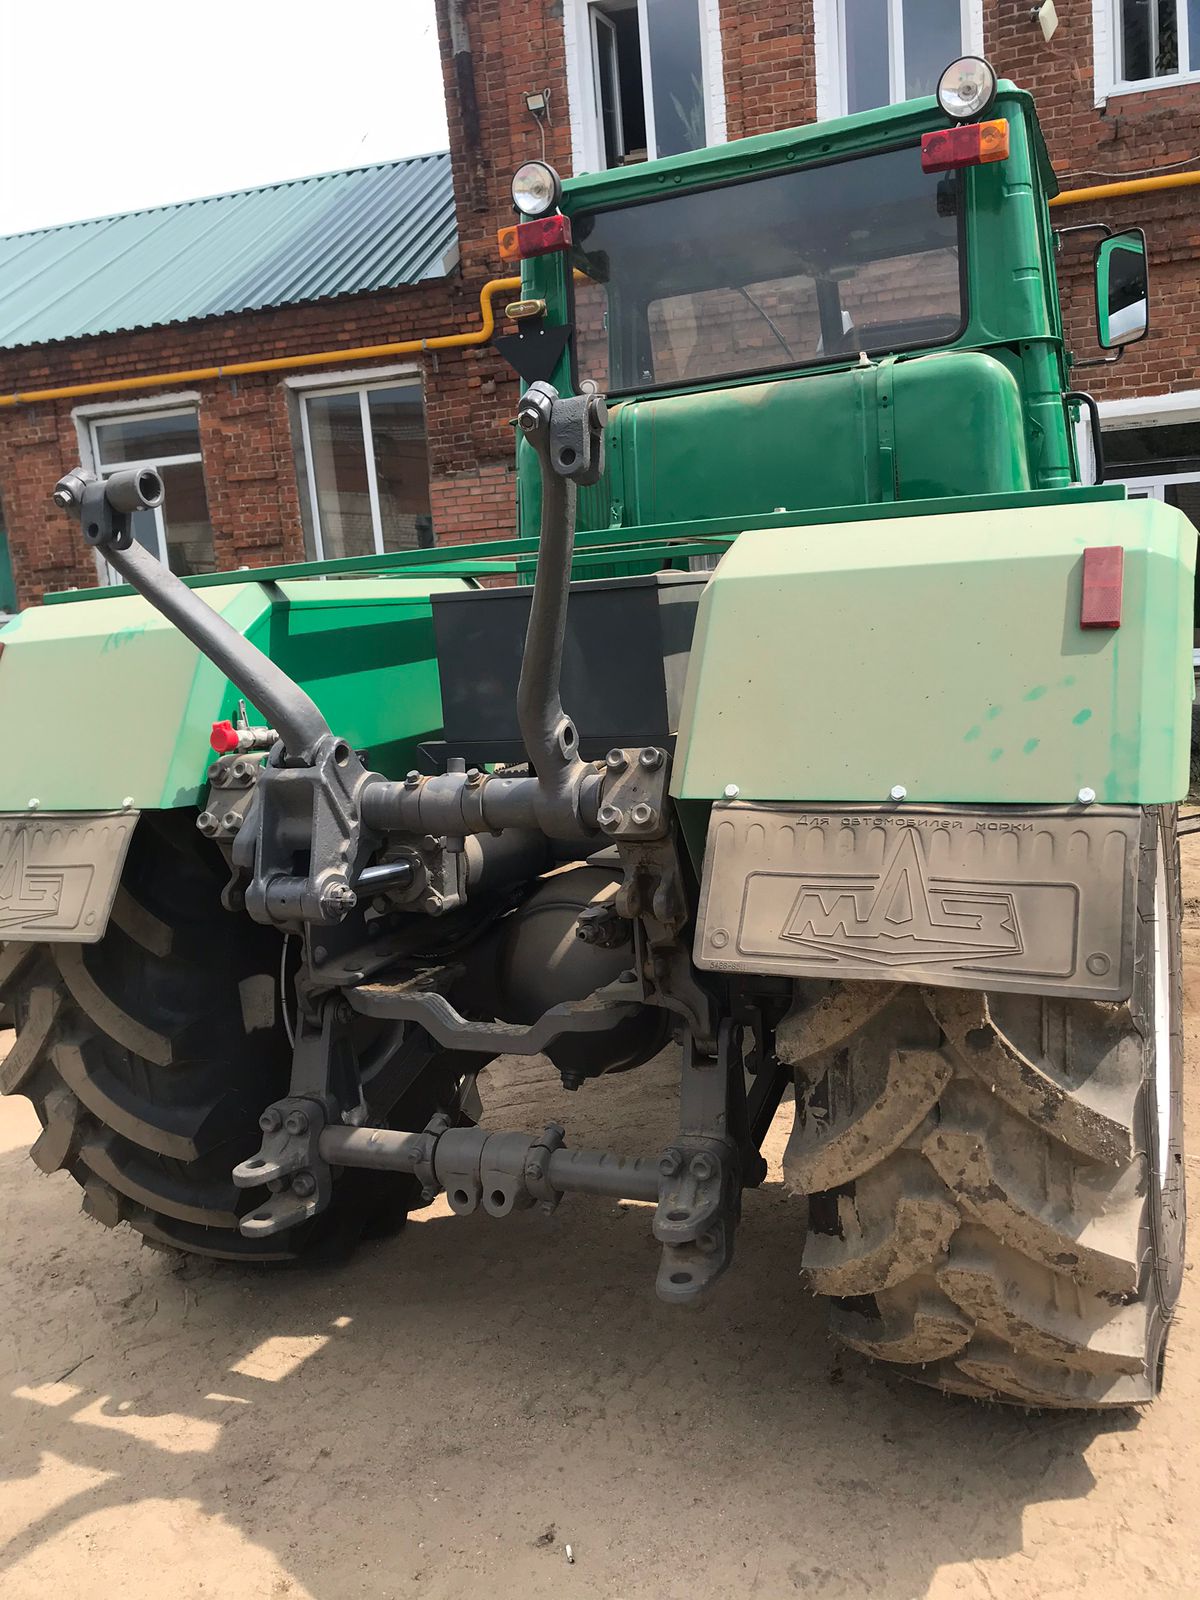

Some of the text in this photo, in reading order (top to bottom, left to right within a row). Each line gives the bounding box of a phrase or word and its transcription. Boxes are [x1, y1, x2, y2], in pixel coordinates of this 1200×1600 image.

[795, 814, 1034, 832] Для автомобилей марки
